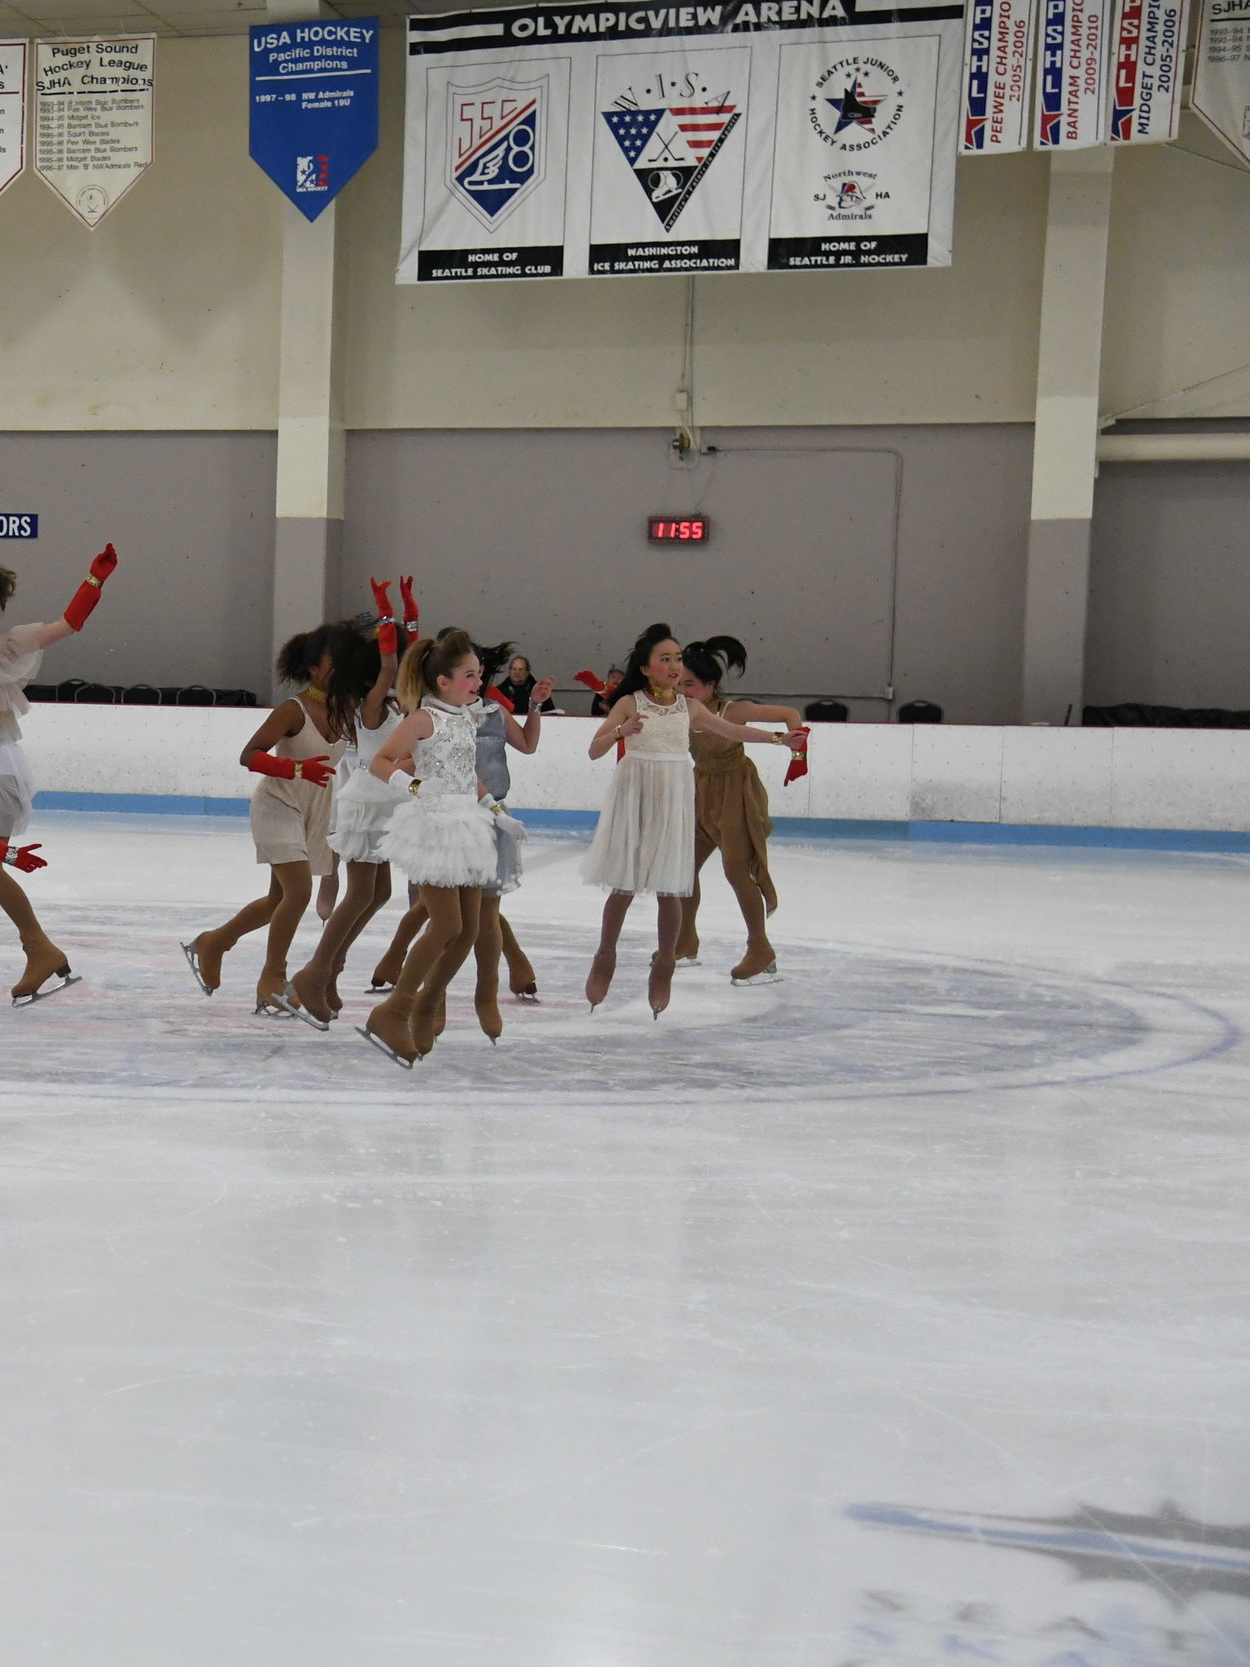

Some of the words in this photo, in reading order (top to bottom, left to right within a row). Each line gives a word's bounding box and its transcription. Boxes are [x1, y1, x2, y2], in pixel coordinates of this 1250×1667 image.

[511, 5, 723, 38] OLYMPICVIEW
[734, 0, 846, 24] ARENA
[253, 31, 291, 52] USA
[296, 26, 374, 43] HOCKEY
[52, 46, 91, 58] Puget
[95, 43, 139, 55] Sound
[269, 46, 311, 63] Pacific
[313, 45, 358, 58] District
[1084, 14, 1099, 95] 2009-2010
[1157, 8, 1177, 93] 2005-2006
[43, 58, 91, 77] Hockey
[100, 57, 148, 73] League
[278, 60, 348, 74] Champions
[1009, 20, 1026, 102] 2005-2006
[815, 56, 860, 88] SEATTLE
[862, 57, 899, 84] JUNIOR
[36, 77, 71, 92] SJHA
[1066, 75, 1081, 140] BANTAM
[1137, 71, 1154, 135] MIDGET
[990, 81, 1006, 144] PEEWEE
[809, 107, 837, 147] HOCKEY
[840, 104, 904, 152] ASSOCIATION
[823, 169, 878, 182] Northwest
[813, 193, 826, 202] SJ
[875, 192, 891, 200] HA
[827, 212, 872, 221] Admirals
[627, 246, 699, 257] WASHINGTON
[821, 242, 856, 251] HOME
[860, 241, 878, 250] OF
[468, 253, 499, 262] HOME
[503, 252, 518, 261] OF
[594, 262, 610, 271] ICE
[614, 261, 659, 271] SKATING
[663, 258, 735, 269] ASSOCIATION
[789, 256, 835, 266] SEATTLE
[839, 255, 856, 265] JR.
[860, 253, 909, 263] HOCKEY
[431, 268, 473, 277] SEATTLE
[477, 266, 521, 276] SKATING
[525, 265, 551, 274] CLUB
[657, 522, 703, 539] 11:55
